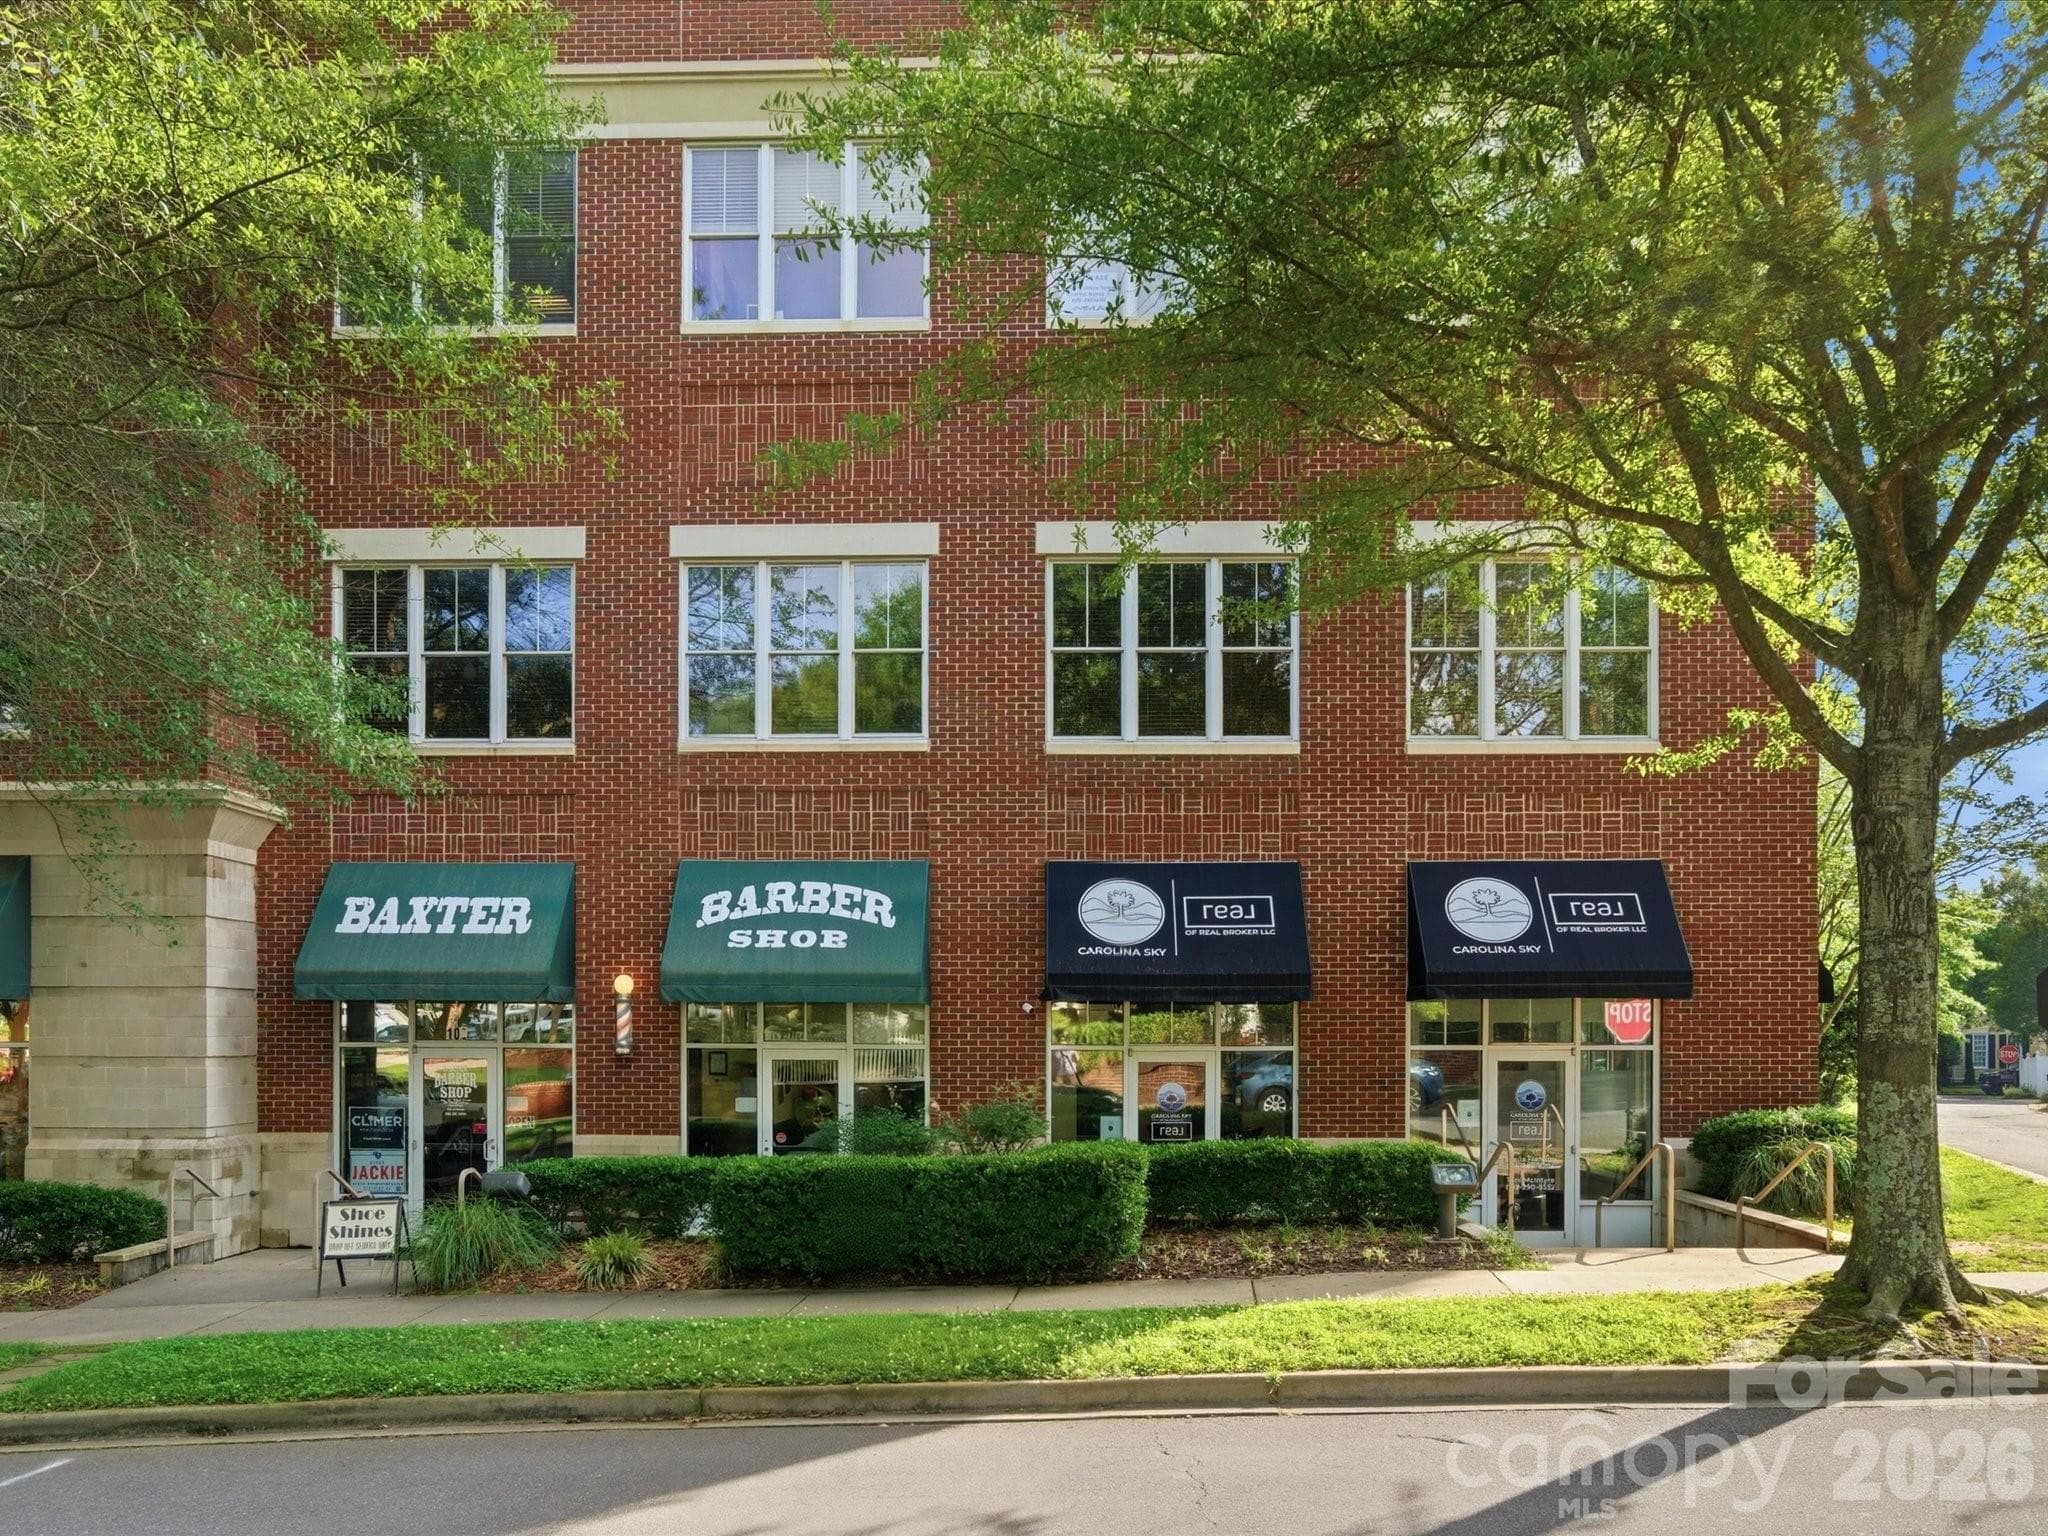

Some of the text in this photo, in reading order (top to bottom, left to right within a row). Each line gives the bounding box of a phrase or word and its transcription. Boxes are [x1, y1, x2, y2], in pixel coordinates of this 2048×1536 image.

[696, 881, 896, 928] BARBER
[335, 896, 532, 935] BAXTER
[1078, 946, 1167, 957] CAROLINA SKY
[1452, 944, 1541, 954] CAROLINA SKY
[434, 1072, 477, 1089] BARBER
[440, 1086, 472, 1099] SHOP
[352, 1165, 404, 1180] JACKIE
[340, 1208, 386, 1221] Shoe
[330, 1225, 393, 1239] Shines
